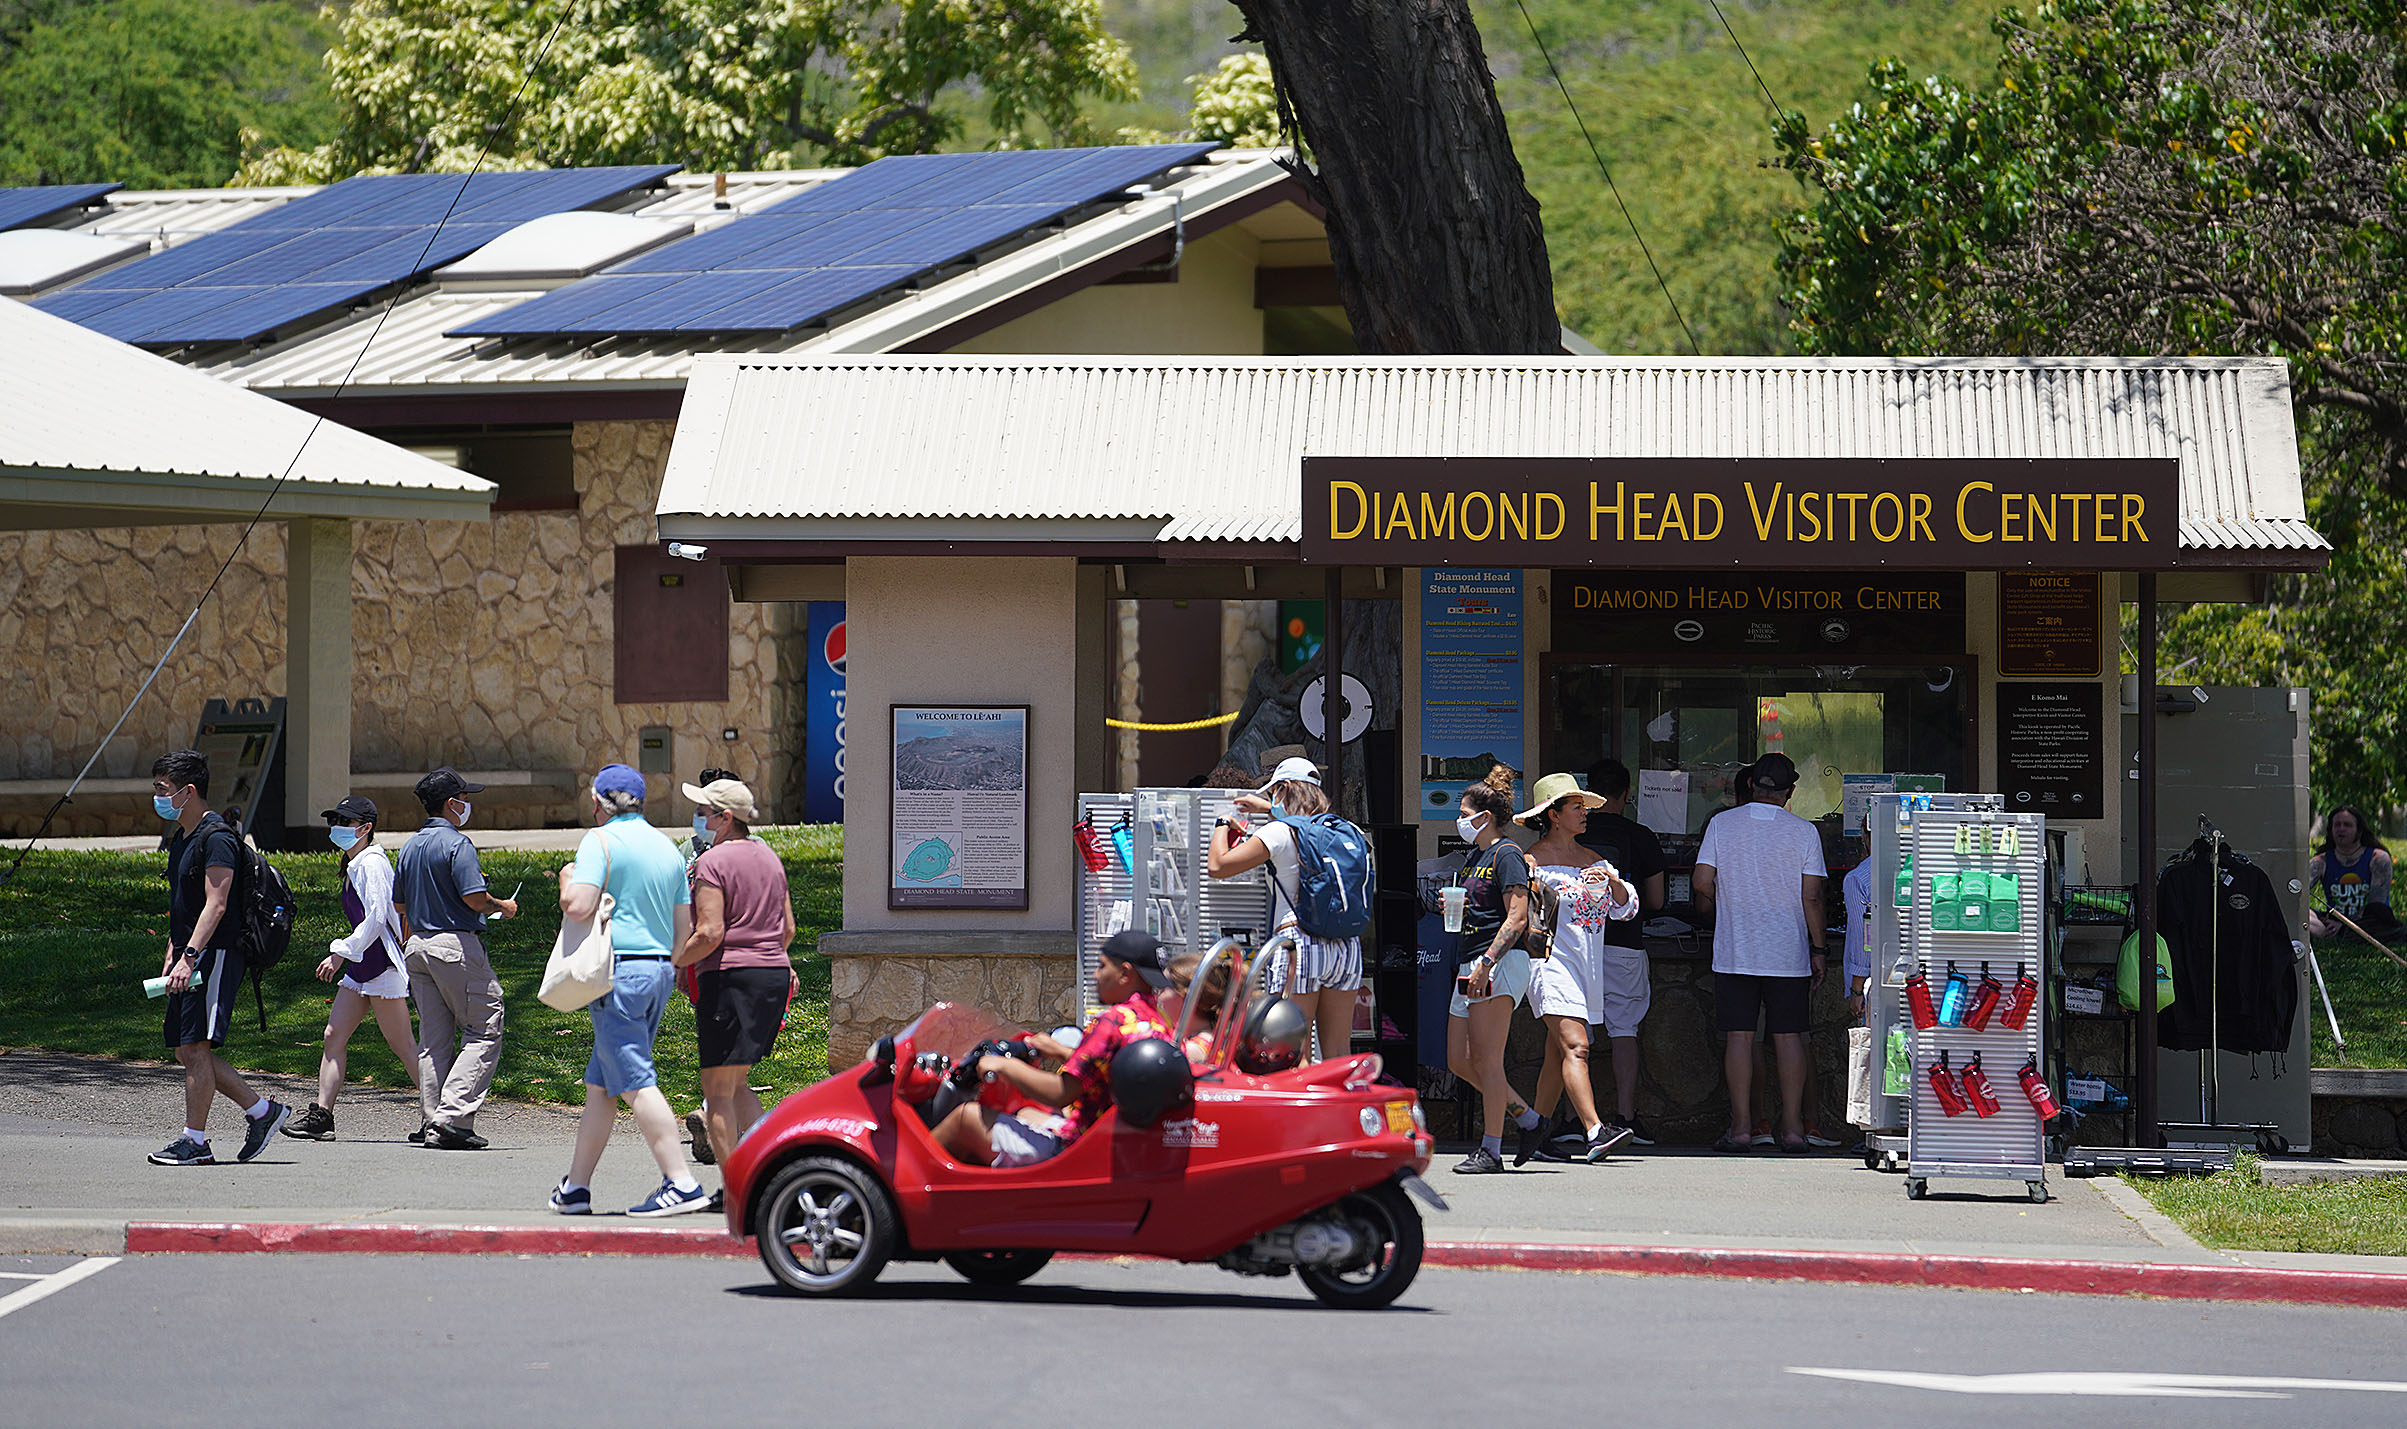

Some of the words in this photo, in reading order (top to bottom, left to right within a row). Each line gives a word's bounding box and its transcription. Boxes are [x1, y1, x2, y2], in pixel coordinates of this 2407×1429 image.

[1330, 480, 1566, 542] DIAMOND
[1589, 481, 1724, 541] HEAD
[1743, 481, 1937, 543] VISITOR
[1956, 480, 2150, 543] CENTER
[1434, 572, 1482, 582] Diamond
[1484, 572, 1511, 582] Head
[2029, 577, 2071, 587] NOTICE
[1429, 584, 1457, 594] State
[1459, 584, 1516, 594] Monument
[1456, 597, 1489, 607] Tours
[1574, 586, 1679, 609] DIAMOND
[1688, 586, 1749, 609] HEAD
[1757, 586, 1843, 610] VISITOR
[1857, 586, 1941, 610] CENTER
[915, 712, 959, 721] WELCOME
[962, 713, 973, 721] TO
